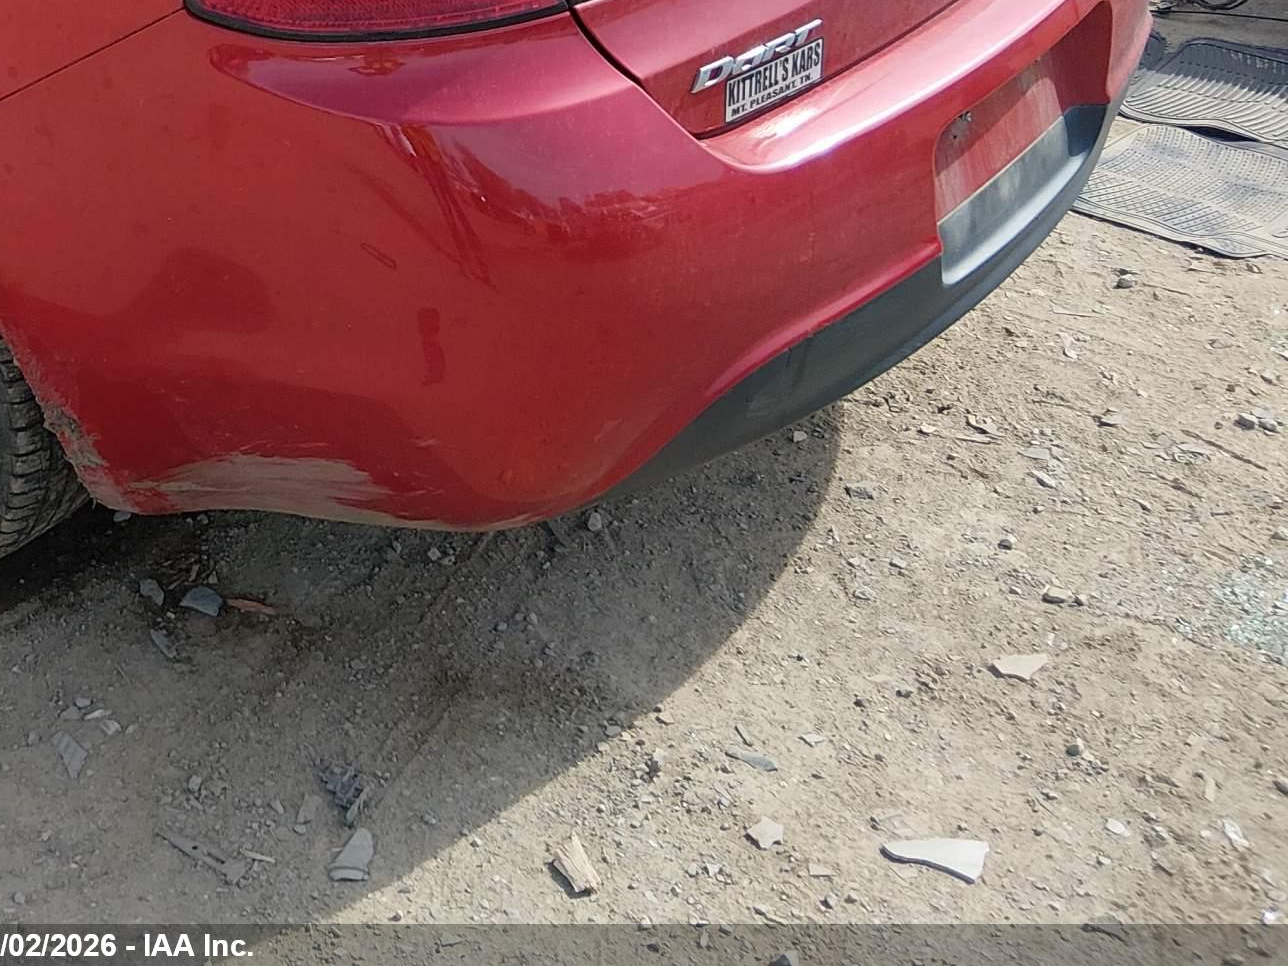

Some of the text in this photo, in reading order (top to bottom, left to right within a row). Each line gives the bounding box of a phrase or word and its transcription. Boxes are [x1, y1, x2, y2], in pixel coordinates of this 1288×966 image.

[690, 18, 823, 94] DART
[727, 42, 820, 107] KITTRELL'S KARS
